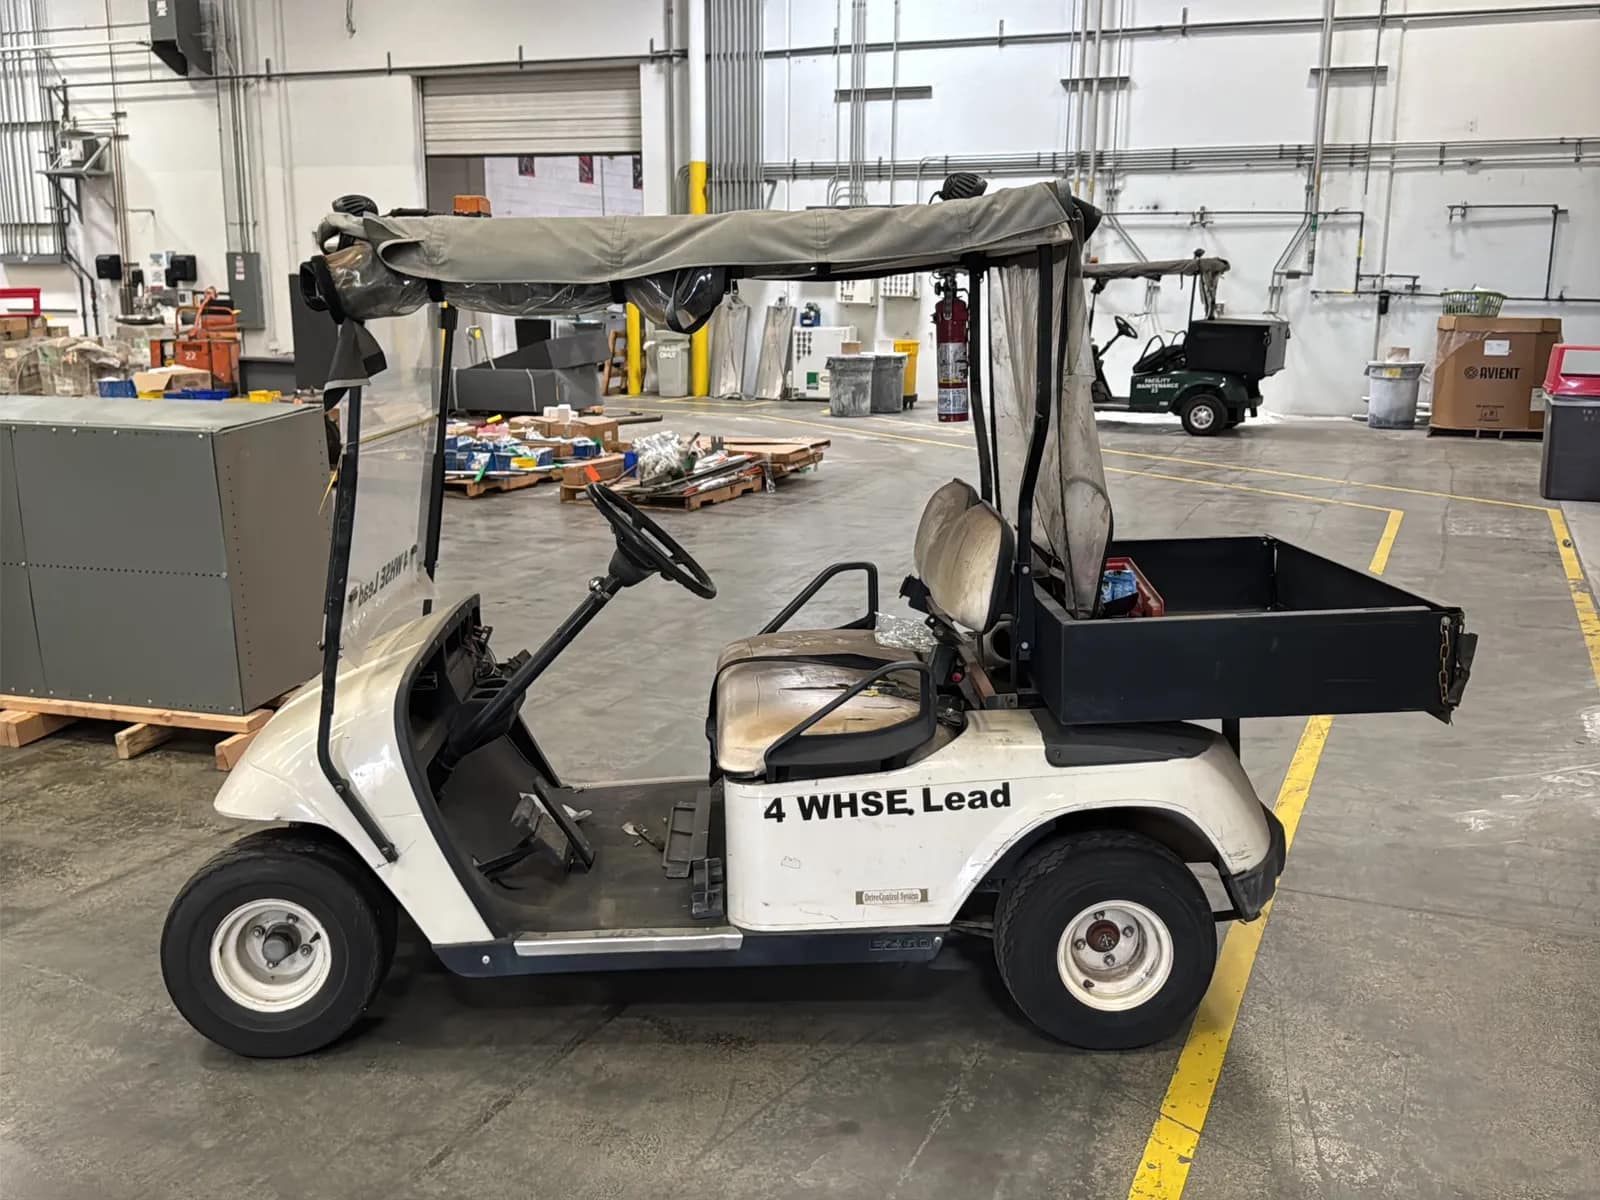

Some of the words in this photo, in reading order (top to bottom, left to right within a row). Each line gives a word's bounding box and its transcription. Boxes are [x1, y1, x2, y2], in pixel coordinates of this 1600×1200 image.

[185, 351, 197, 361] 22
[1480, 366, 1521, 380] AVIENT
[763, 797, 786, 823] 4
[922, 782, 1011, 812] Lead
